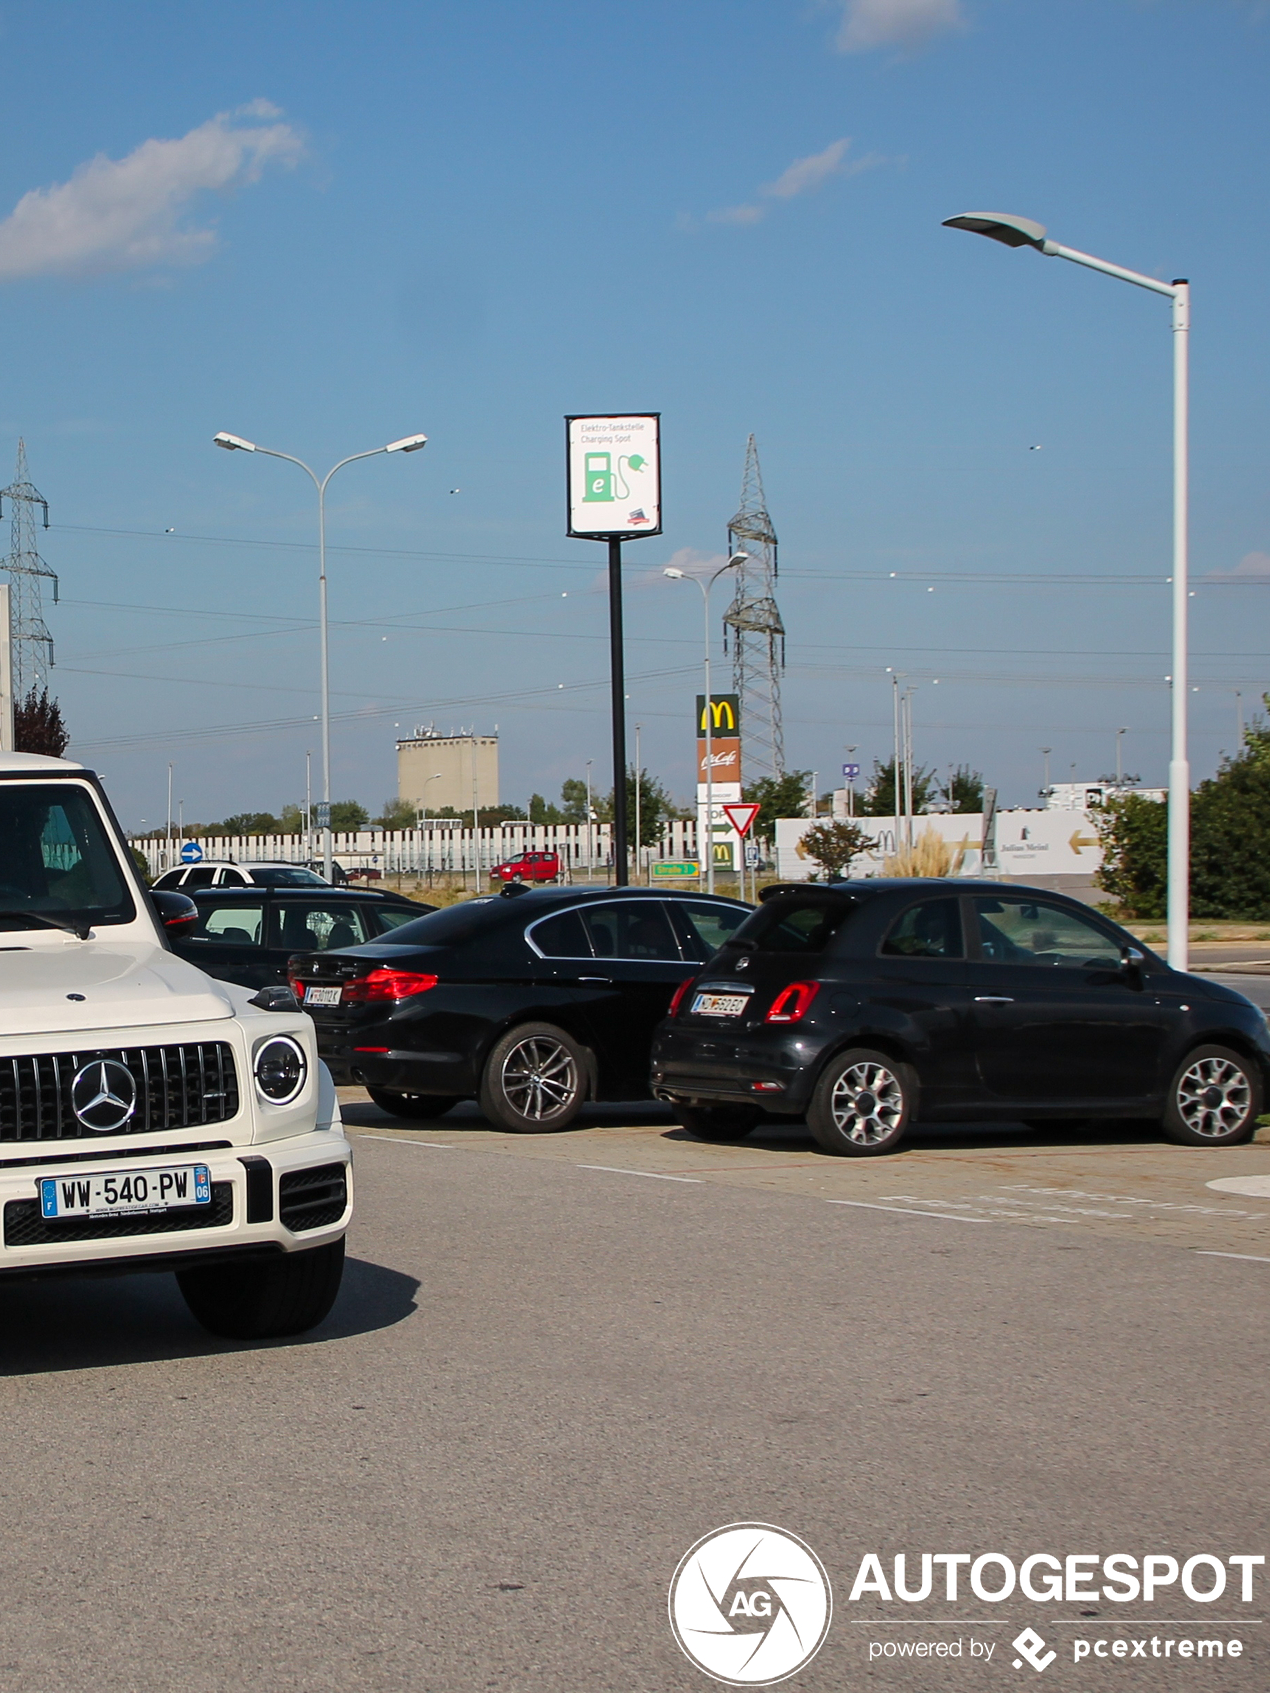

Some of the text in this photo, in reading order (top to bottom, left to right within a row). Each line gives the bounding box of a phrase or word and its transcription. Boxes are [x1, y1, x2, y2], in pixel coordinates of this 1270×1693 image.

[580, 423, 645, 432] Elektro-Tankstelle
[580, 434, 632, 444] Charging Spot
[1000, 843, 1049, 852] Julius Meinl
[196, 1185, 209, 1198] 06
[47, 1201, 53, 1210] F
